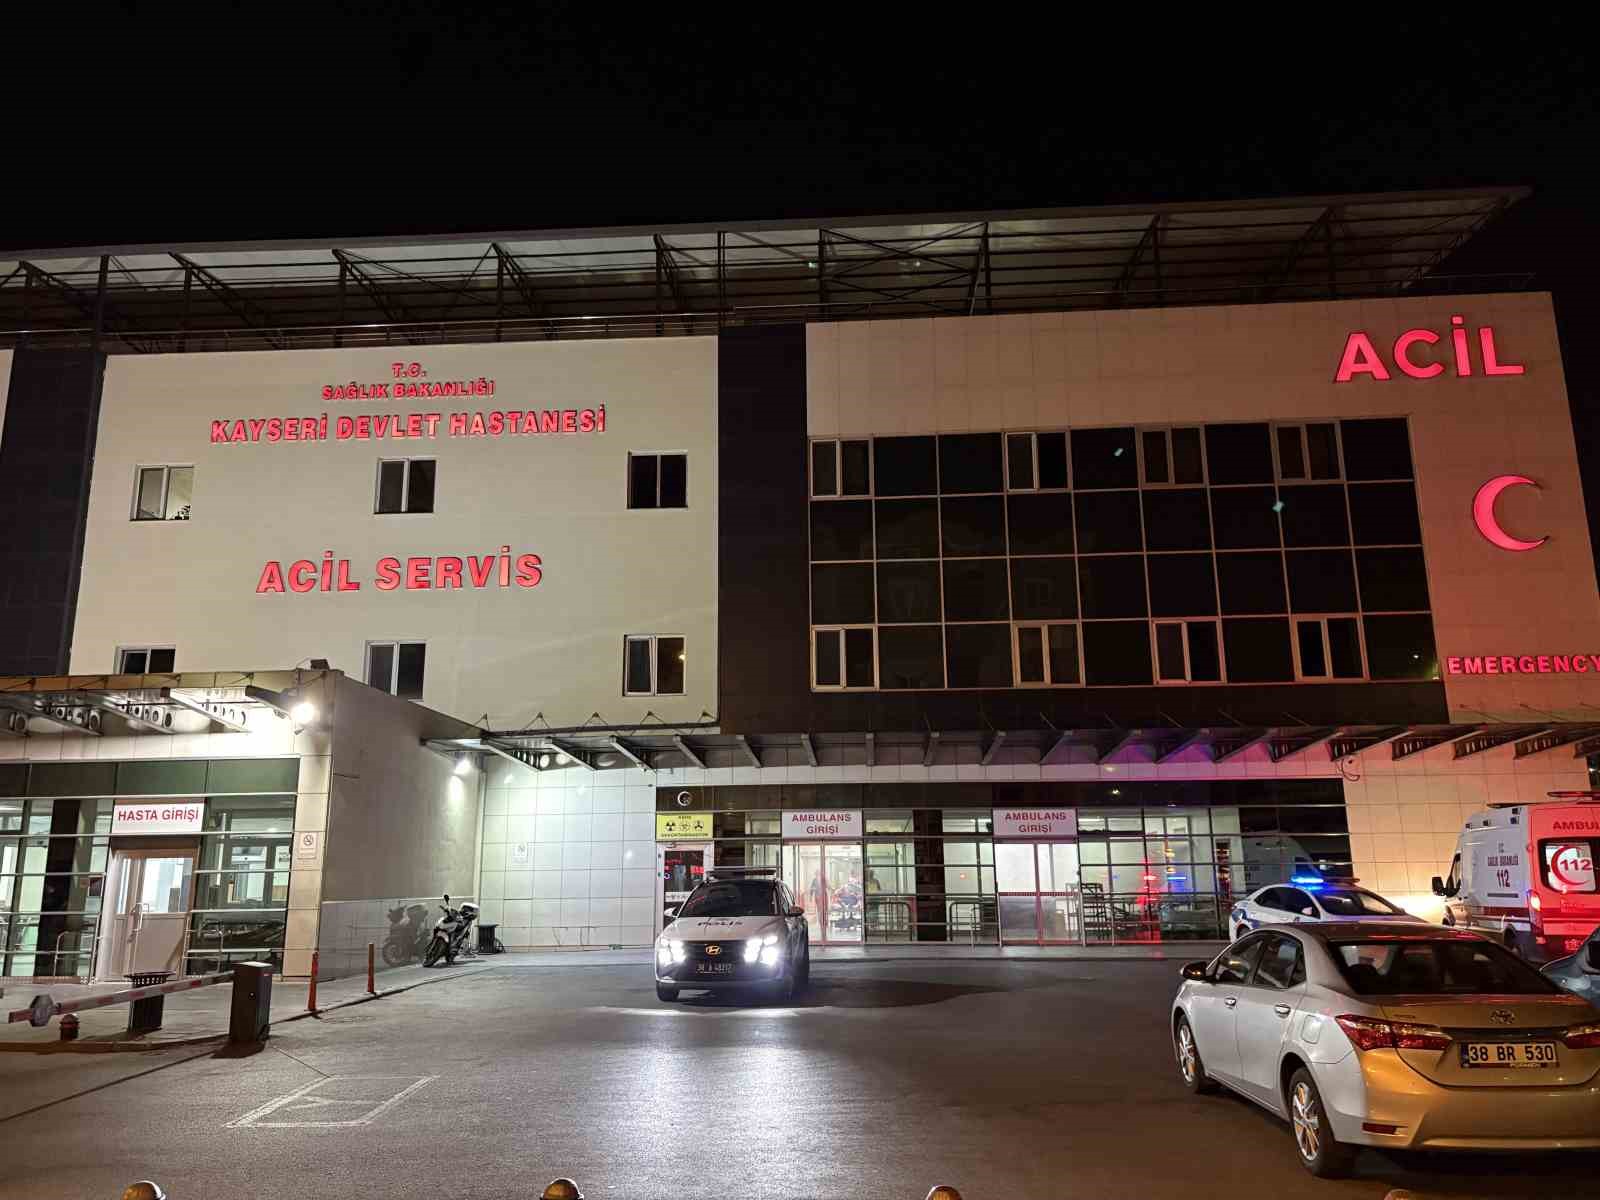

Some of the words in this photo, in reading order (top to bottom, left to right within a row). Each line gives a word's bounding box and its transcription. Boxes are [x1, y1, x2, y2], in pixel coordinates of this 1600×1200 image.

[1334, 315, 1526, 383] ACİL
[391, 362, 427, 378] T.C.
[322, 382, 389, 400] SAĞLIK
[393, 378, 496, 398] BAKANLIĞI
[210, 413, 328, 443] KAYSERİ
[335, 413, 441, 440] DEVLET
[449, 404, 607, 437] HASTANESİ
[256, 551, 360, 593] ACİL
[375, 546, 543, 590] SERVİS
[118, 809, 158, 822] HASTA
[162, 806, 199, 822] GİRİŞİ
[792, 813, 852, 822] AMBULANS
[1005, 811, 1066, 821] AMBULANS
[806, 823, 839, 834] GİRİŞİ
[1018, 822, 1052, 834] GİRİŞİ
[1560, 859, 1593, 871] 112
[1496, 869, 1510, 888] 112
[1470, 1046, 1489, 1061] 38
[1497, 1045, 1517, 1061] BR
[1525, 1045, 1554, 1061] 530
